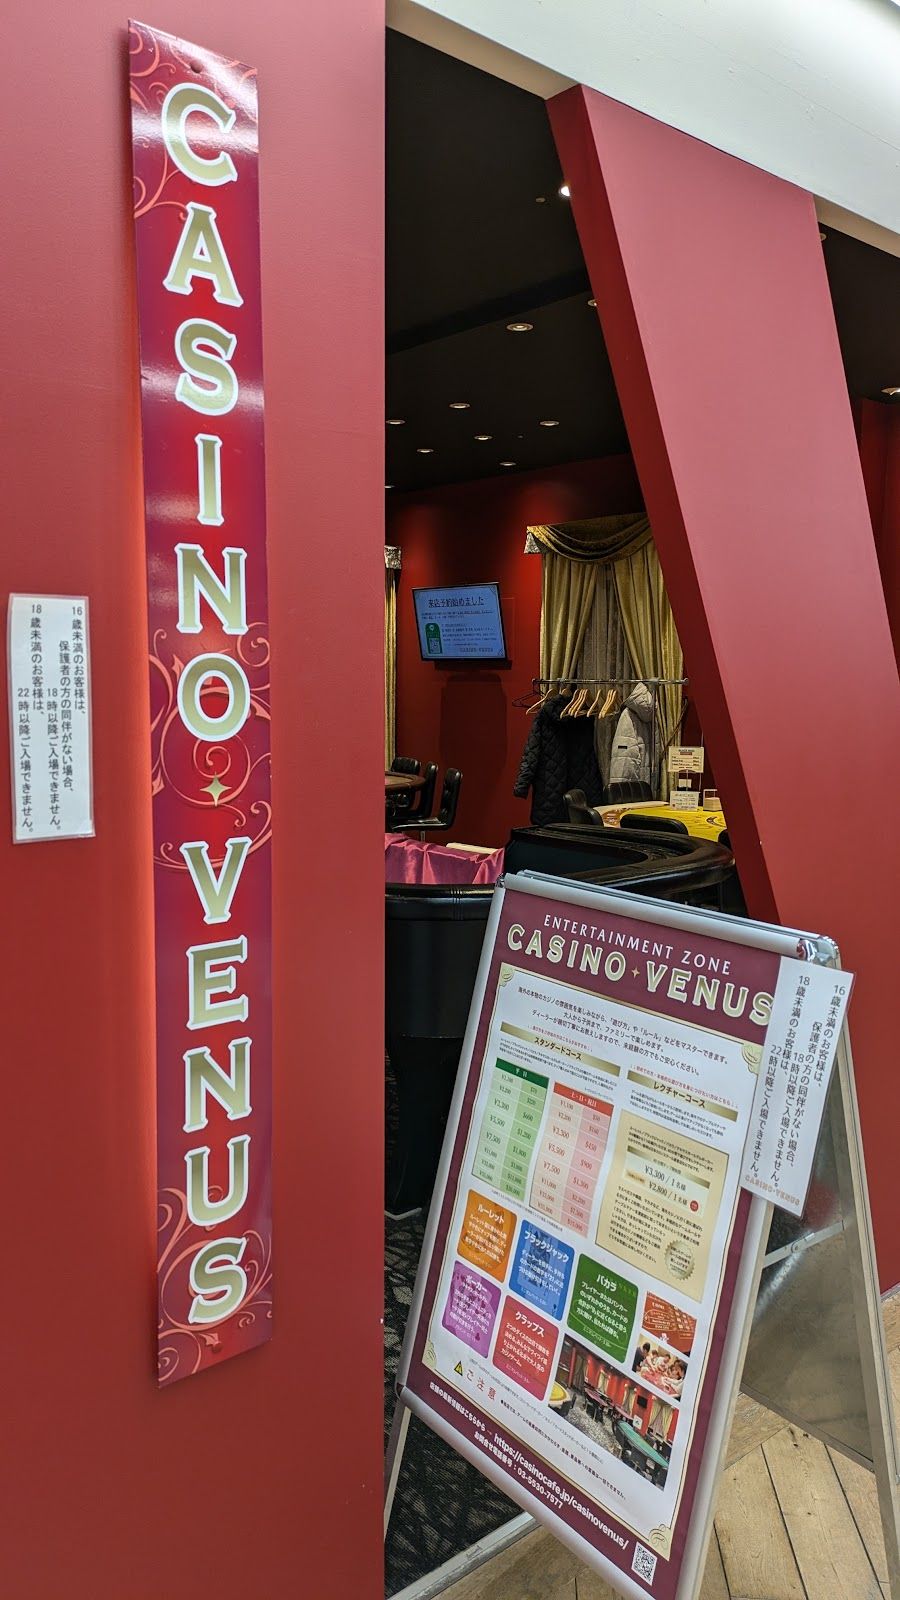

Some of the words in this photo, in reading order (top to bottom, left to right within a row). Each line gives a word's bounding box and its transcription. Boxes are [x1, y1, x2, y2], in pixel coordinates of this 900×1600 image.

[161, 82, 251, 742] CASINO
[544, 914, 674, 960] ENTERTAINMENT
[682, 941, 732, 976] ZONE
[507, 924, 626, 982] CASINO
[646, 962, 774, 1026] VENUS
[534, 1036, 582, 1060] スタンダードコース
[179, 836, 252, 1323] VENUS
[652, 1081, 706, 1108] レクチャーコース
[477, 1203, 504, 1225] ルーレット
[523, 1229, 569, 1264] ブラックジャック
[465, 1273, 488, 1295] ポーカー
[596, 1272, 617, 1294] バカラ
[514, 1309, 545, 1338] クラップス
[494, 1432, 629, 1550] https://casinocafe.jp/casinovenus/
